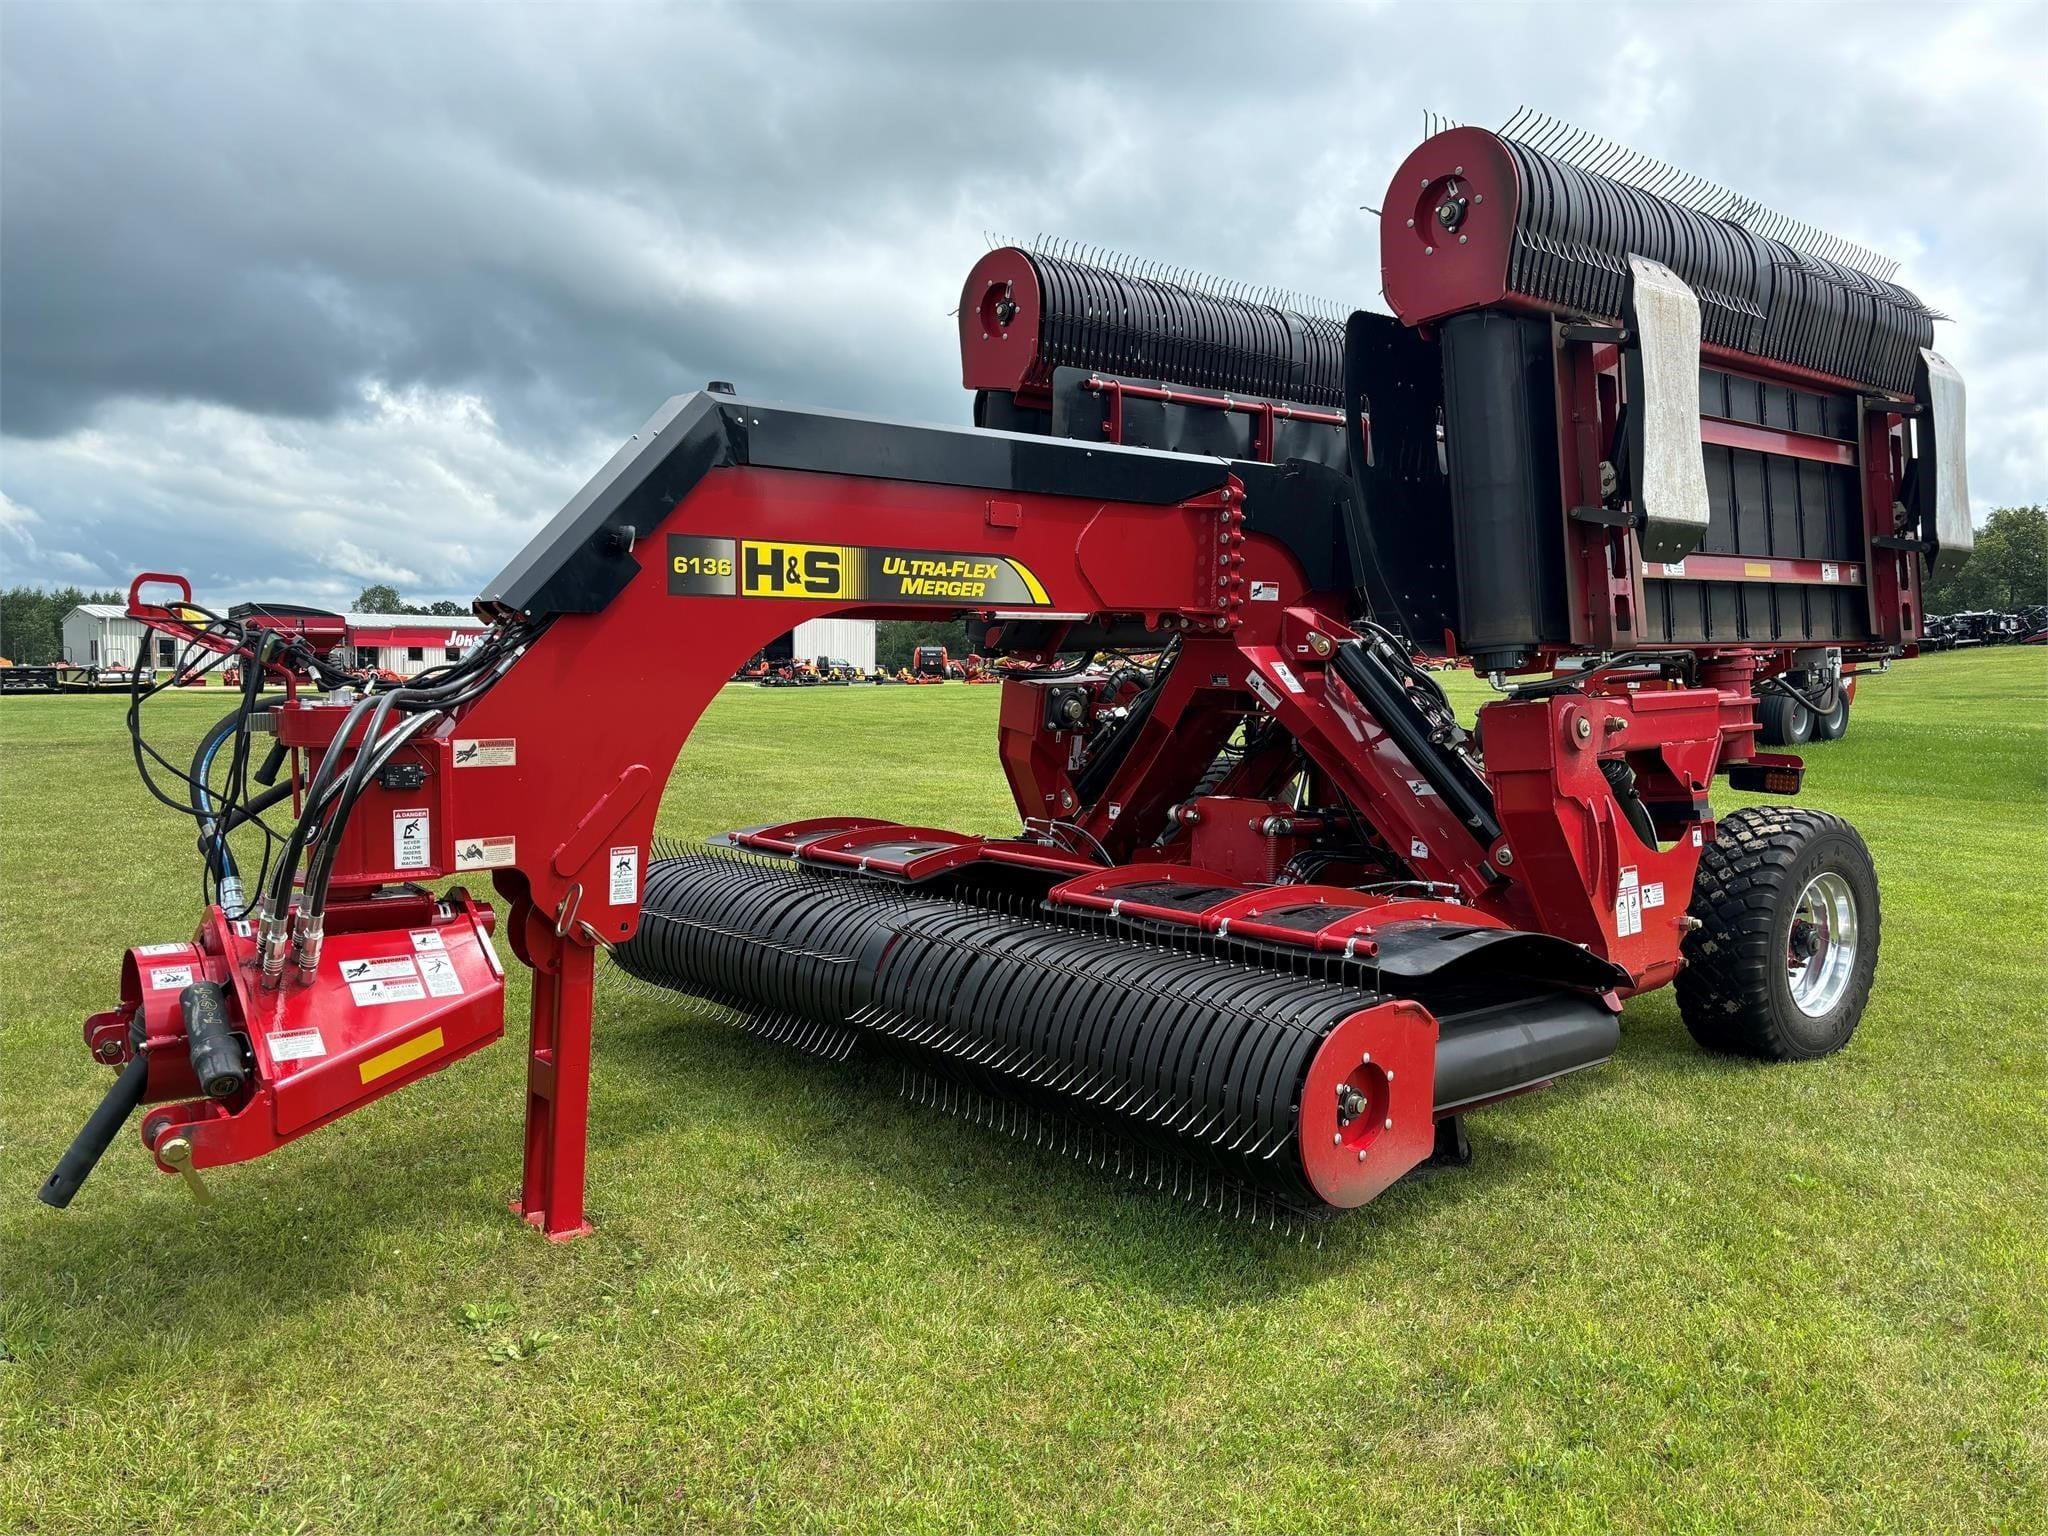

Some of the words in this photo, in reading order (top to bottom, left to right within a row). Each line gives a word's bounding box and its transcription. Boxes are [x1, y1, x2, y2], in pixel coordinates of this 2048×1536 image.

[673, 556, 732, 576] 6136
[745, 547, 840, 594] H&S
[882, 557, 998, 579] ULTRA-FLEX
[900, 577, 986, 597] MERGER
